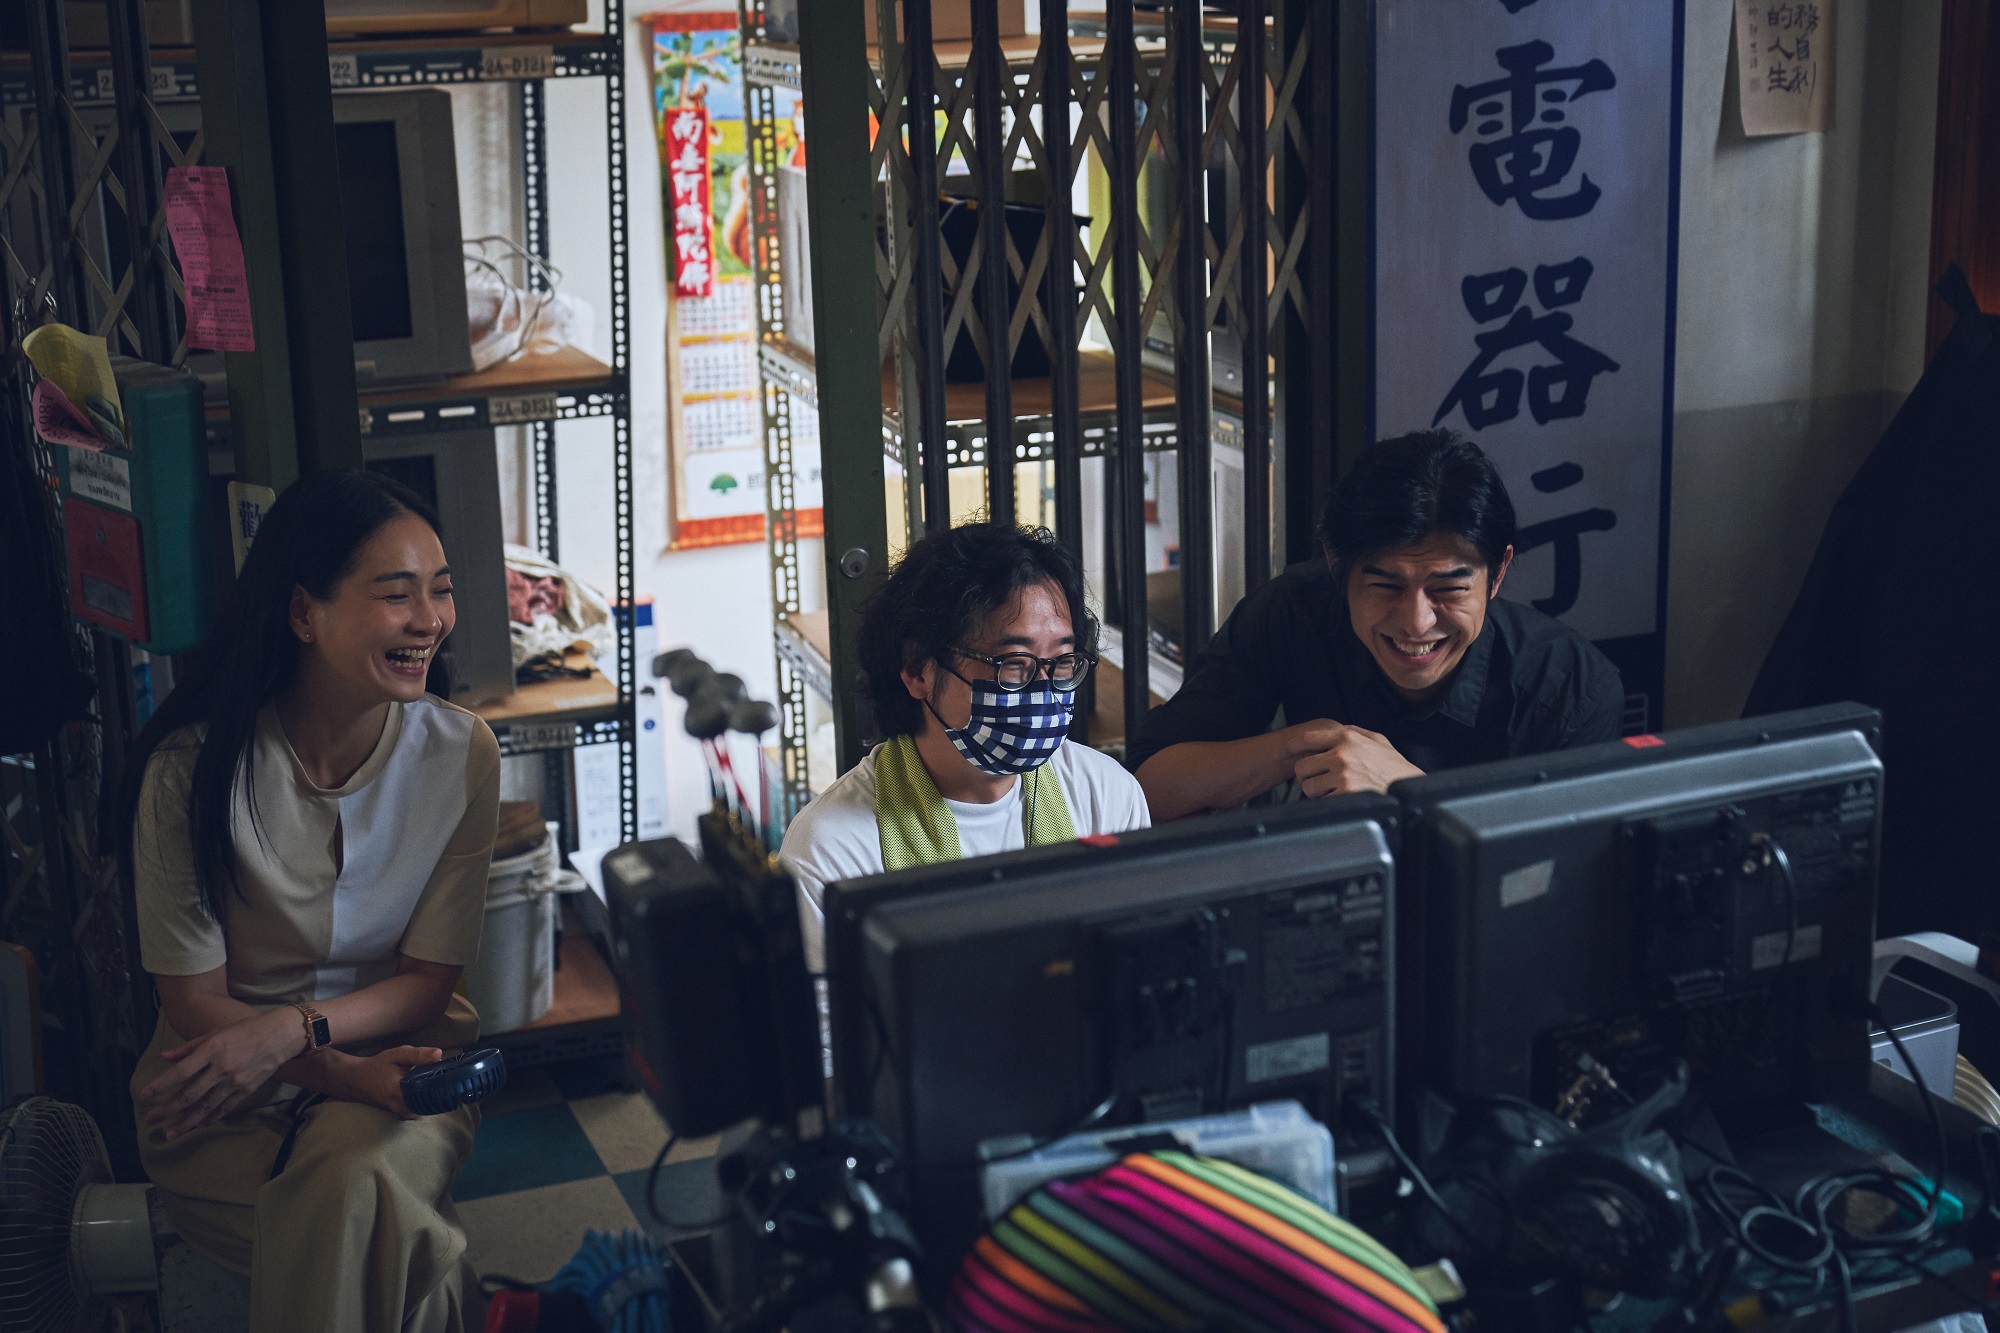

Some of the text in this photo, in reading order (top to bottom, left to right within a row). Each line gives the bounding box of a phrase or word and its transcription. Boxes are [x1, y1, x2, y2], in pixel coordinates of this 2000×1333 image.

[1767, 3, 1795, 92] 的人生
[1431, 0, 1619, 618] 電器行
